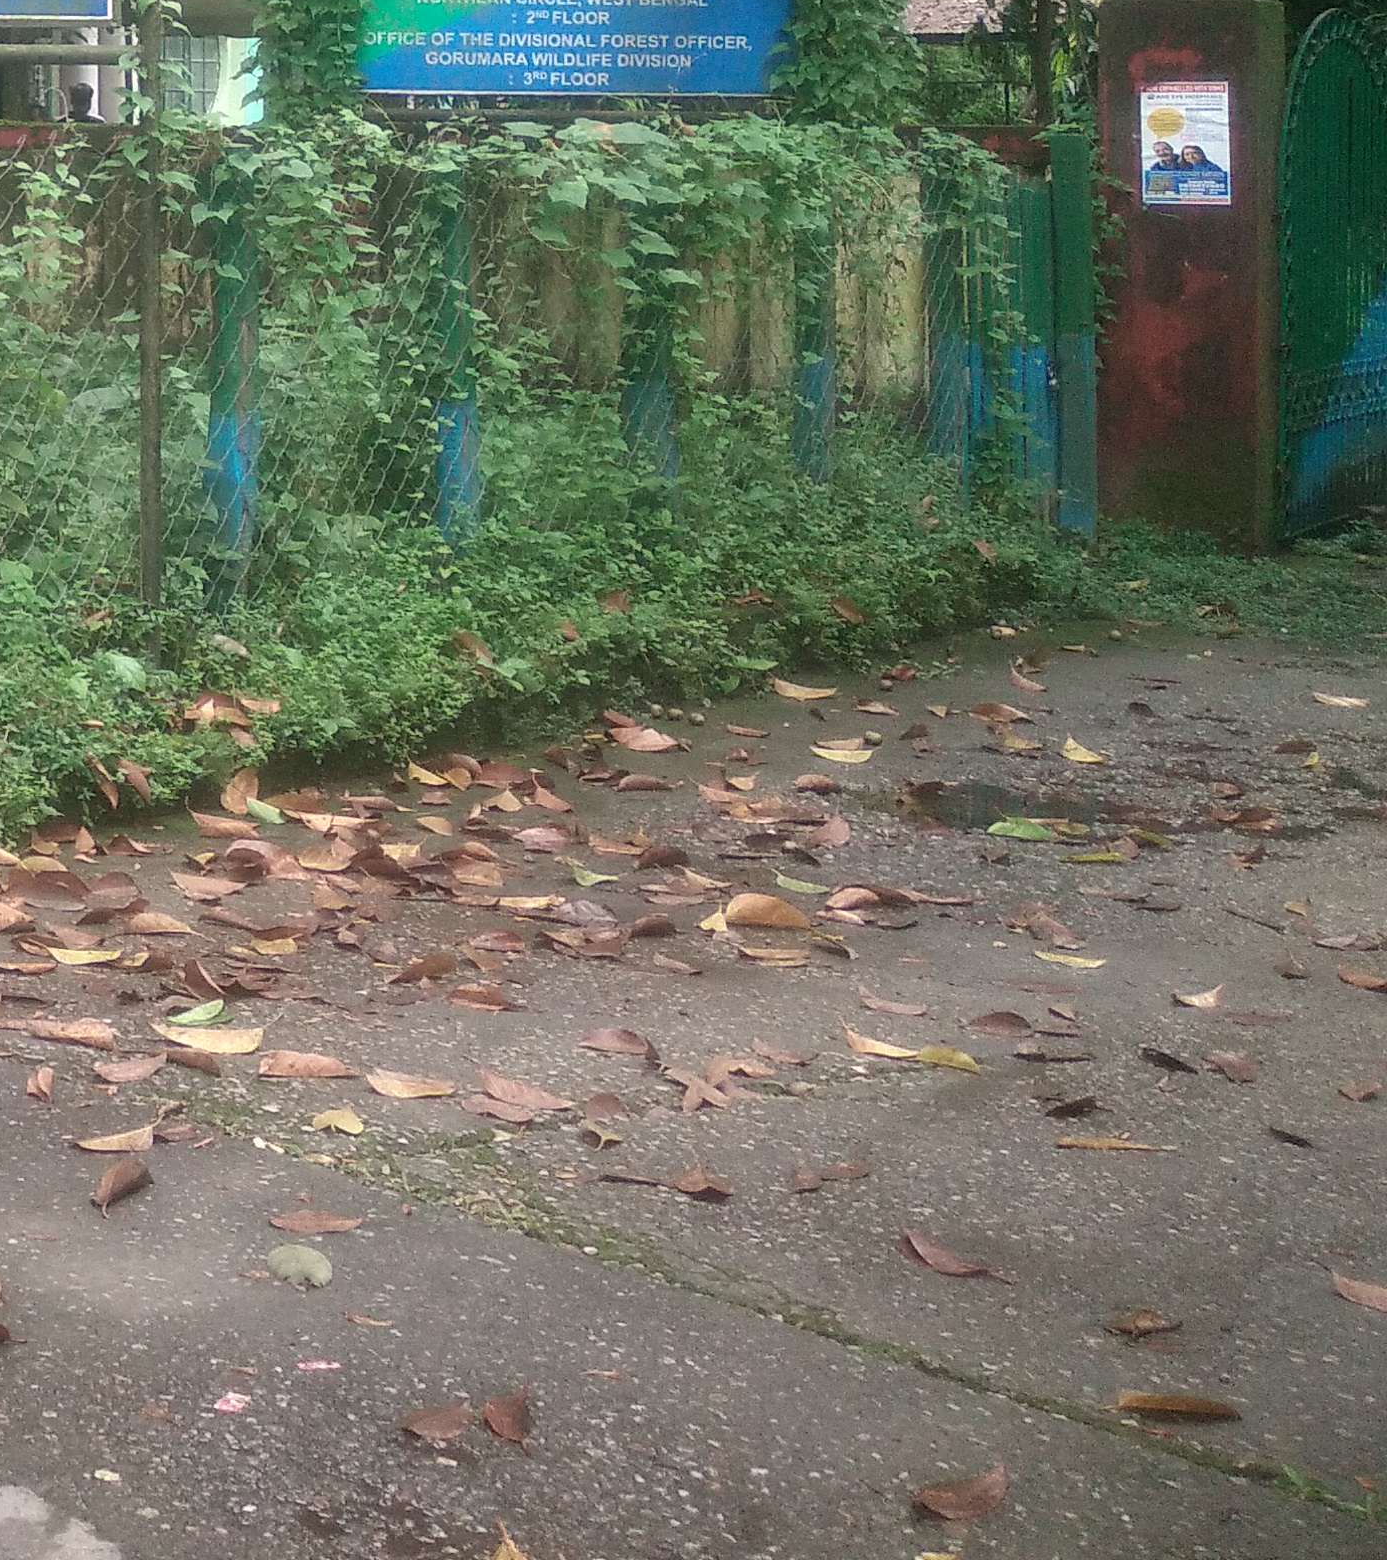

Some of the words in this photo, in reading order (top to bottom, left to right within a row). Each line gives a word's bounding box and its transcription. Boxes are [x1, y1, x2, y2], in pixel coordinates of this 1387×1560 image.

[526, 10, 550, 25] 2ND
[551, 11, 611, 26] FLOOR
[363, 31, 427, 46] OFFICE
[430, 32, 457, 47] OF
[459, 32, 495, 47] THE
[498, 32, 596, 48] DIVISIONAL
[600, 34, 670, 49] FOREST
[674, 34, 754, 52] OFFICER,
[424, 51, 529, 66] GORUMARA
[531, 52, 613, 68] WILDLIFE
[616, 53, 693, 69] DIVISION
[523, 71, 548, 86] 3RD
[549, 72, 610, 87] FLOOR
